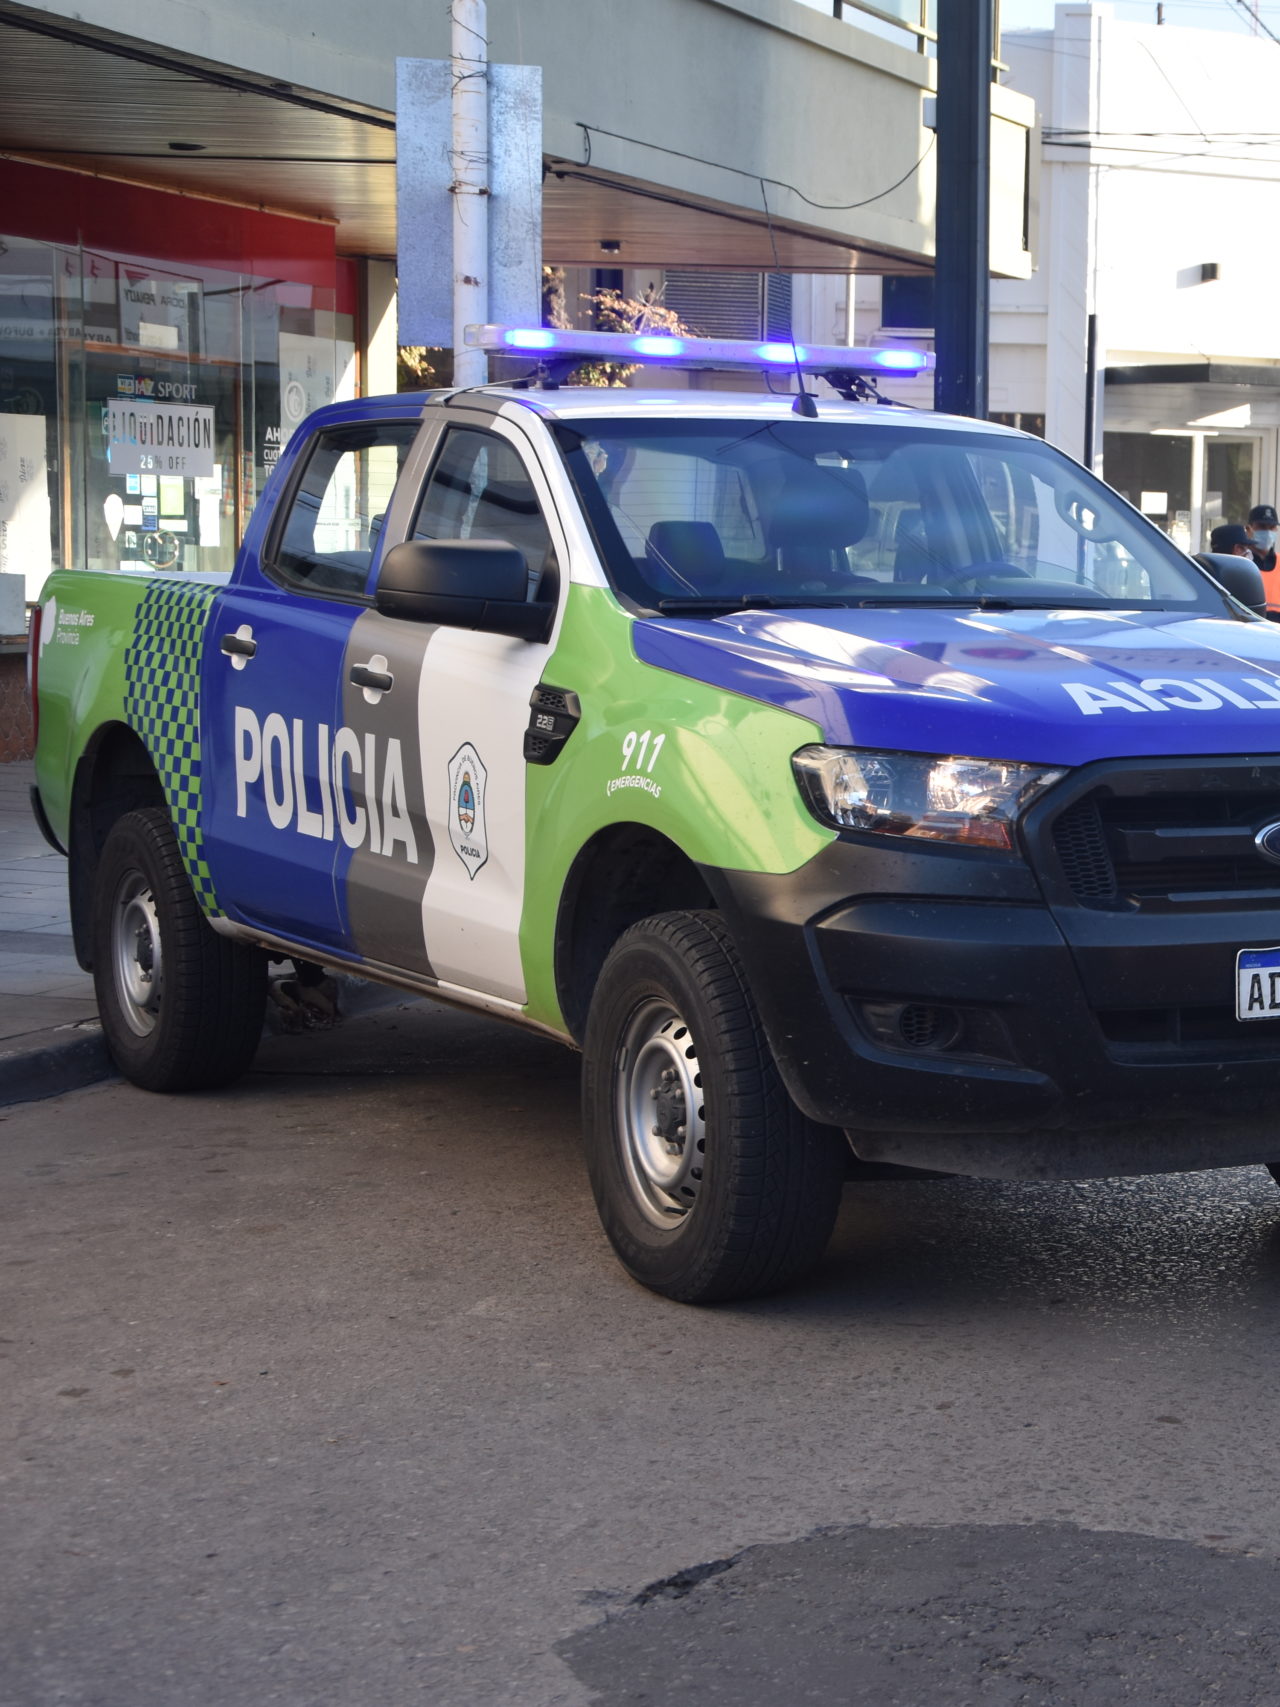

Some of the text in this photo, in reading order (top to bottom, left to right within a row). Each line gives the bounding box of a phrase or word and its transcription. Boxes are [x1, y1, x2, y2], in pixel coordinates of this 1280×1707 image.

[157, 381, 198, 400] SPORT
[140, 454, 187, 470] 25% OFF
[59, 609, 95, 627] Buenos Aires
[621, 730, 666, 773] 911
[235, 705, 419, 865] POLICIA
[611, 775, 662, 798] EMERGENCIAS
[460, 845, 481, 859] POLICIA
